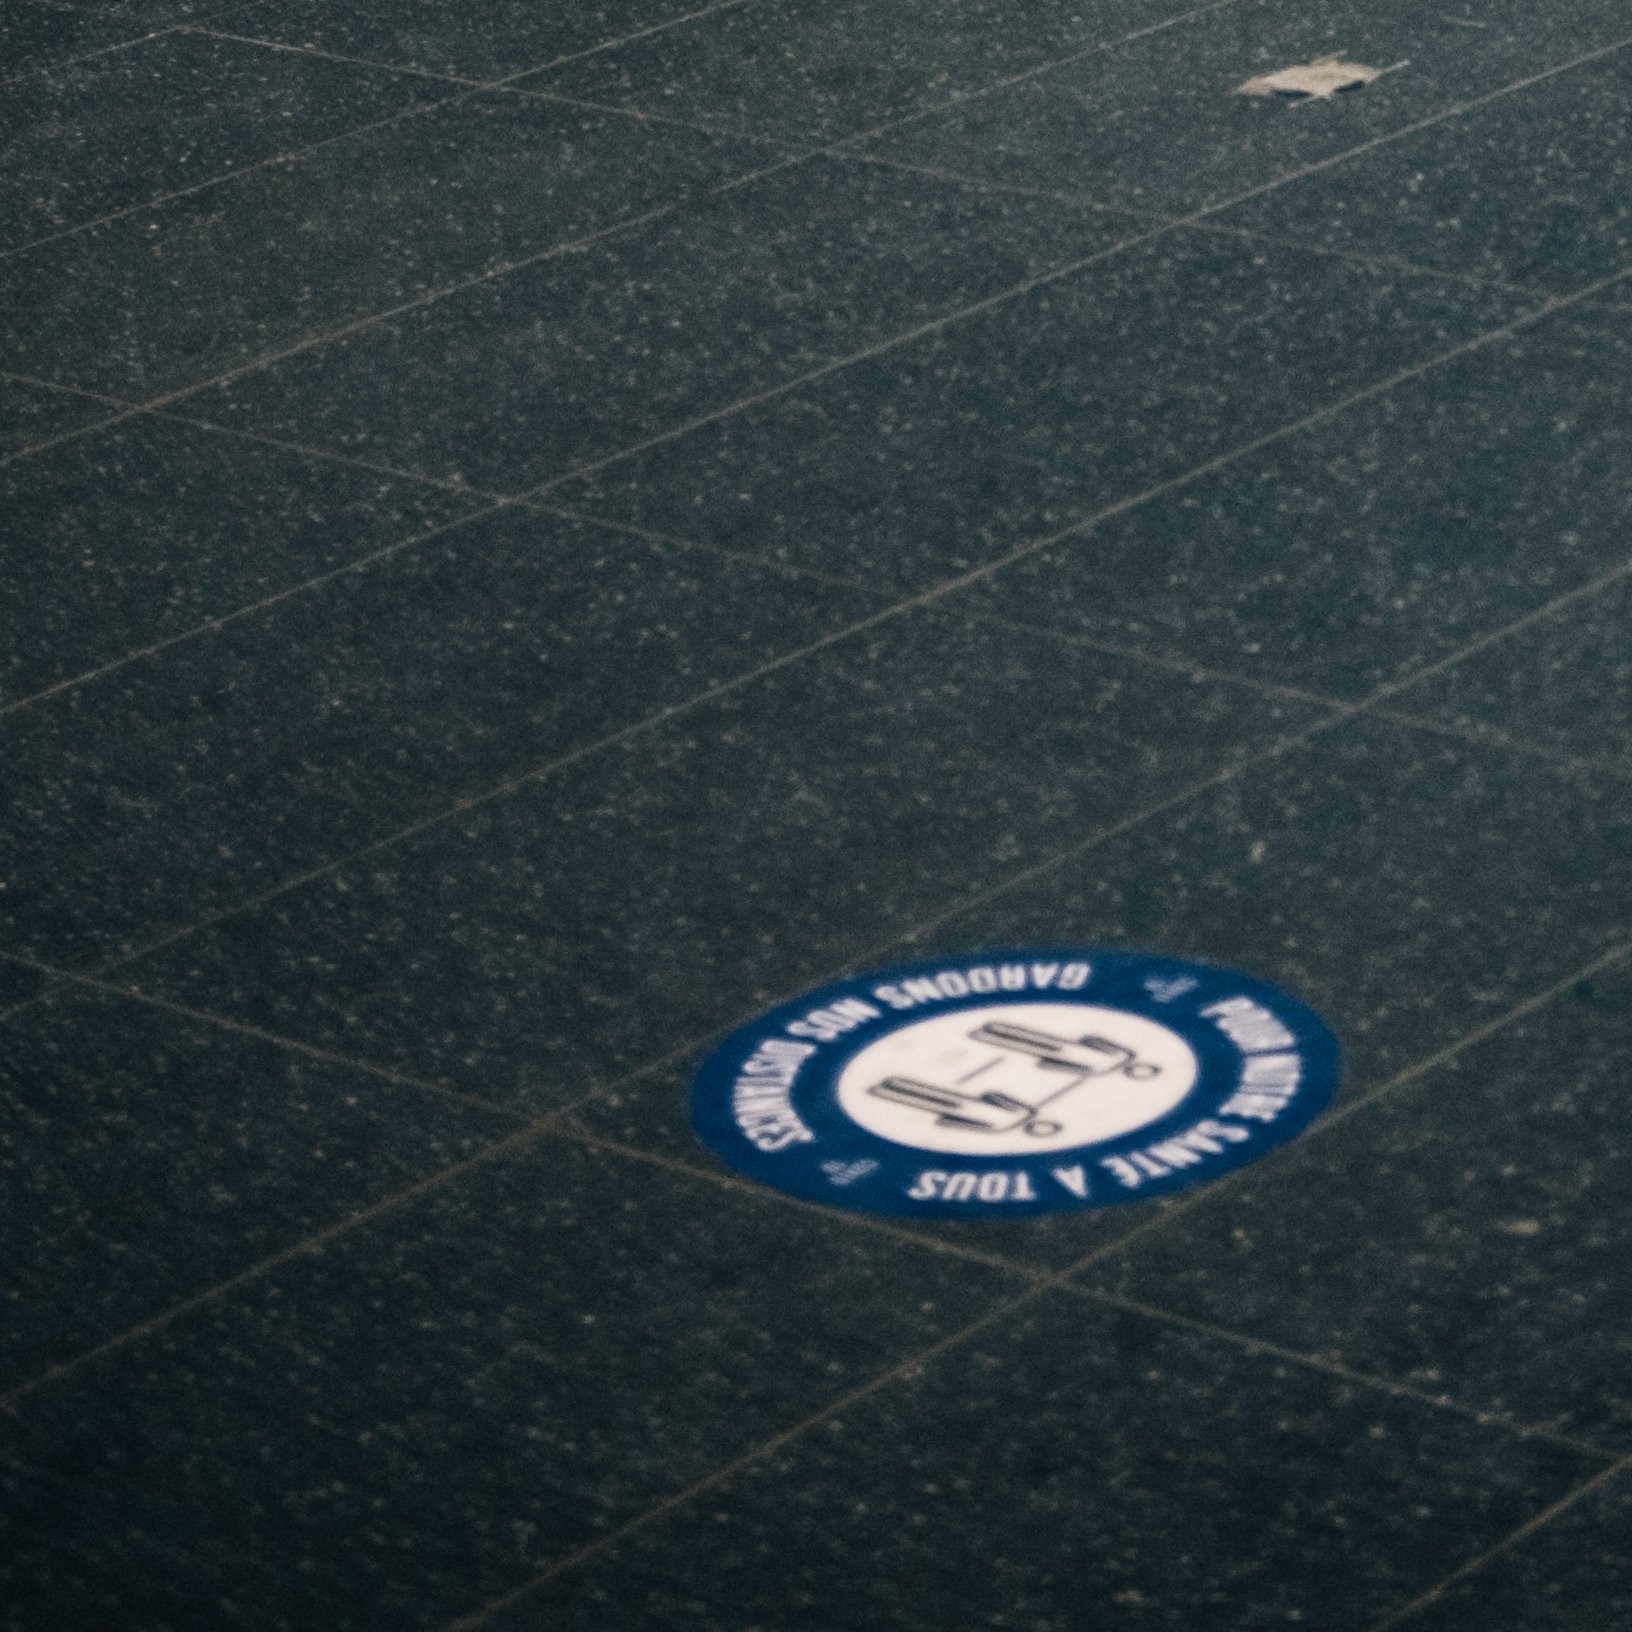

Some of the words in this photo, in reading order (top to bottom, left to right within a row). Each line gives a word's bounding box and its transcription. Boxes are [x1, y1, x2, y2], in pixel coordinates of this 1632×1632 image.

[874, 961, 1092, 1010] GARDONS
[786, 996, 881, 1042] NOS
[906, 1169, 1038, 1203] TOUS
